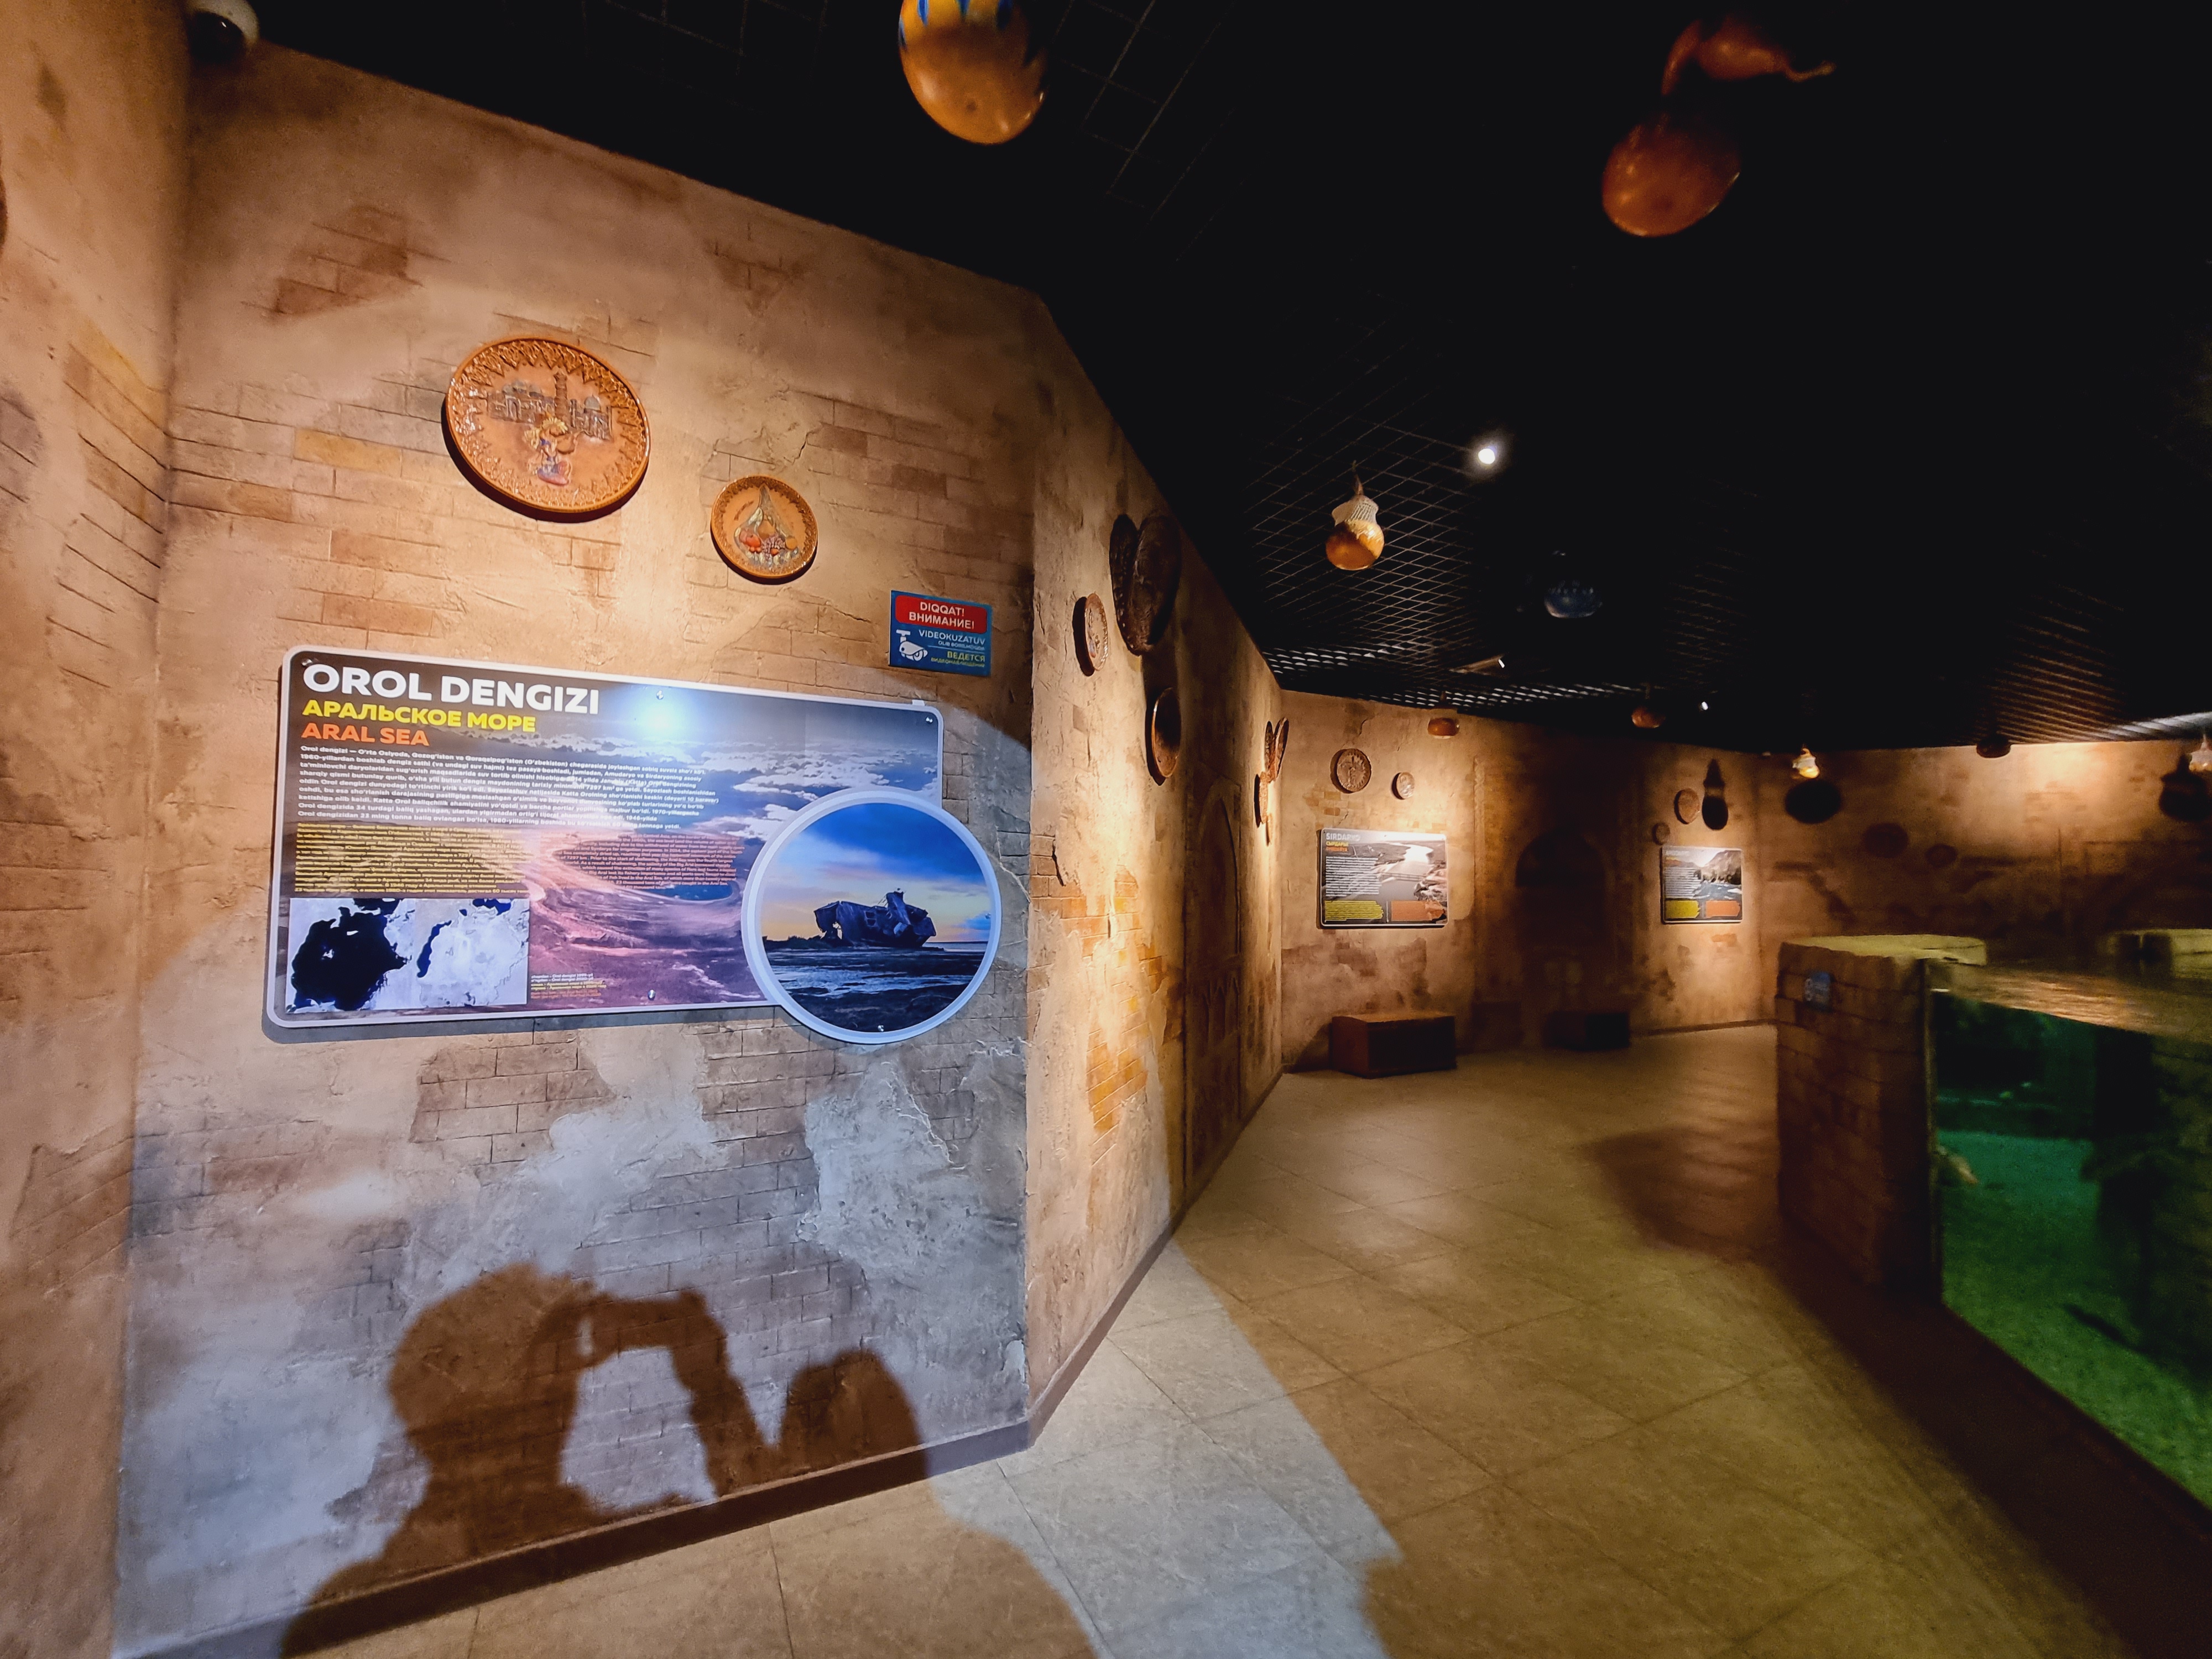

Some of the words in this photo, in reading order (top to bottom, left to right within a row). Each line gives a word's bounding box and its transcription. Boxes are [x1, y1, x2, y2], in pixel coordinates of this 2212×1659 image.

[920, 602, 964, 617] DIQQAT!
[909, 612, 974, 629] ВНИМАНИЕ!
[919, 630, 985, 645] VIDEOKUZATUV
[947, 651, 985, 662] ВЕДЕТСЯ
[304, 664, 432, 701] OROL
[441, 676, 599, 714] DENGIZI
[302, 700, 462, 727] АРАЛЬСКОЕ
[467, 712, 536, 733] МОРЕ
[301, 722, 375, 743] ARAL
[380, 727, 430, 747] SEA
